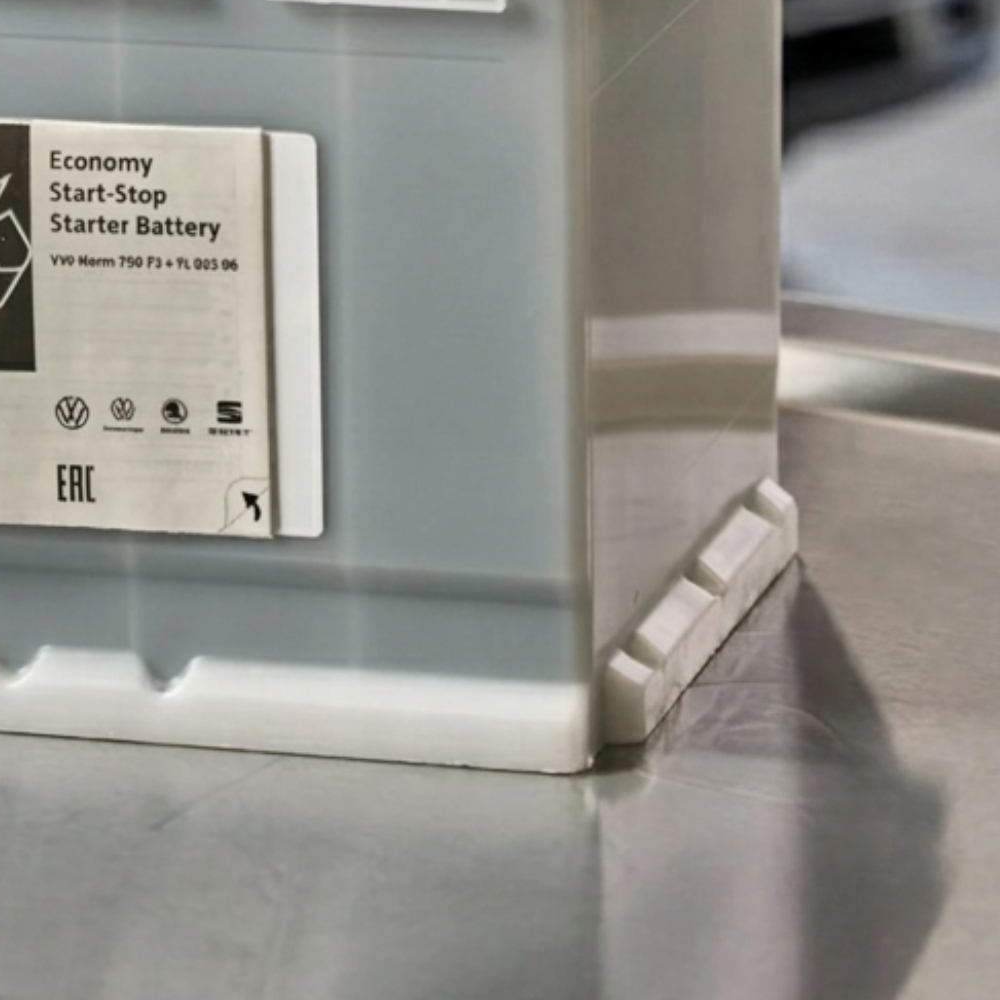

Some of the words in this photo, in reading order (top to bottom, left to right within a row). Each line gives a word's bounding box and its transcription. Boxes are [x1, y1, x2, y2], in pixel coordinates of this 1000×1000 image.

[49, 150, 153, 177] Economy
[49, 181, 168, 209] Start-Stop
[50, 212, 129, 235] Starter
[135, 215, 221, 243] Battery
